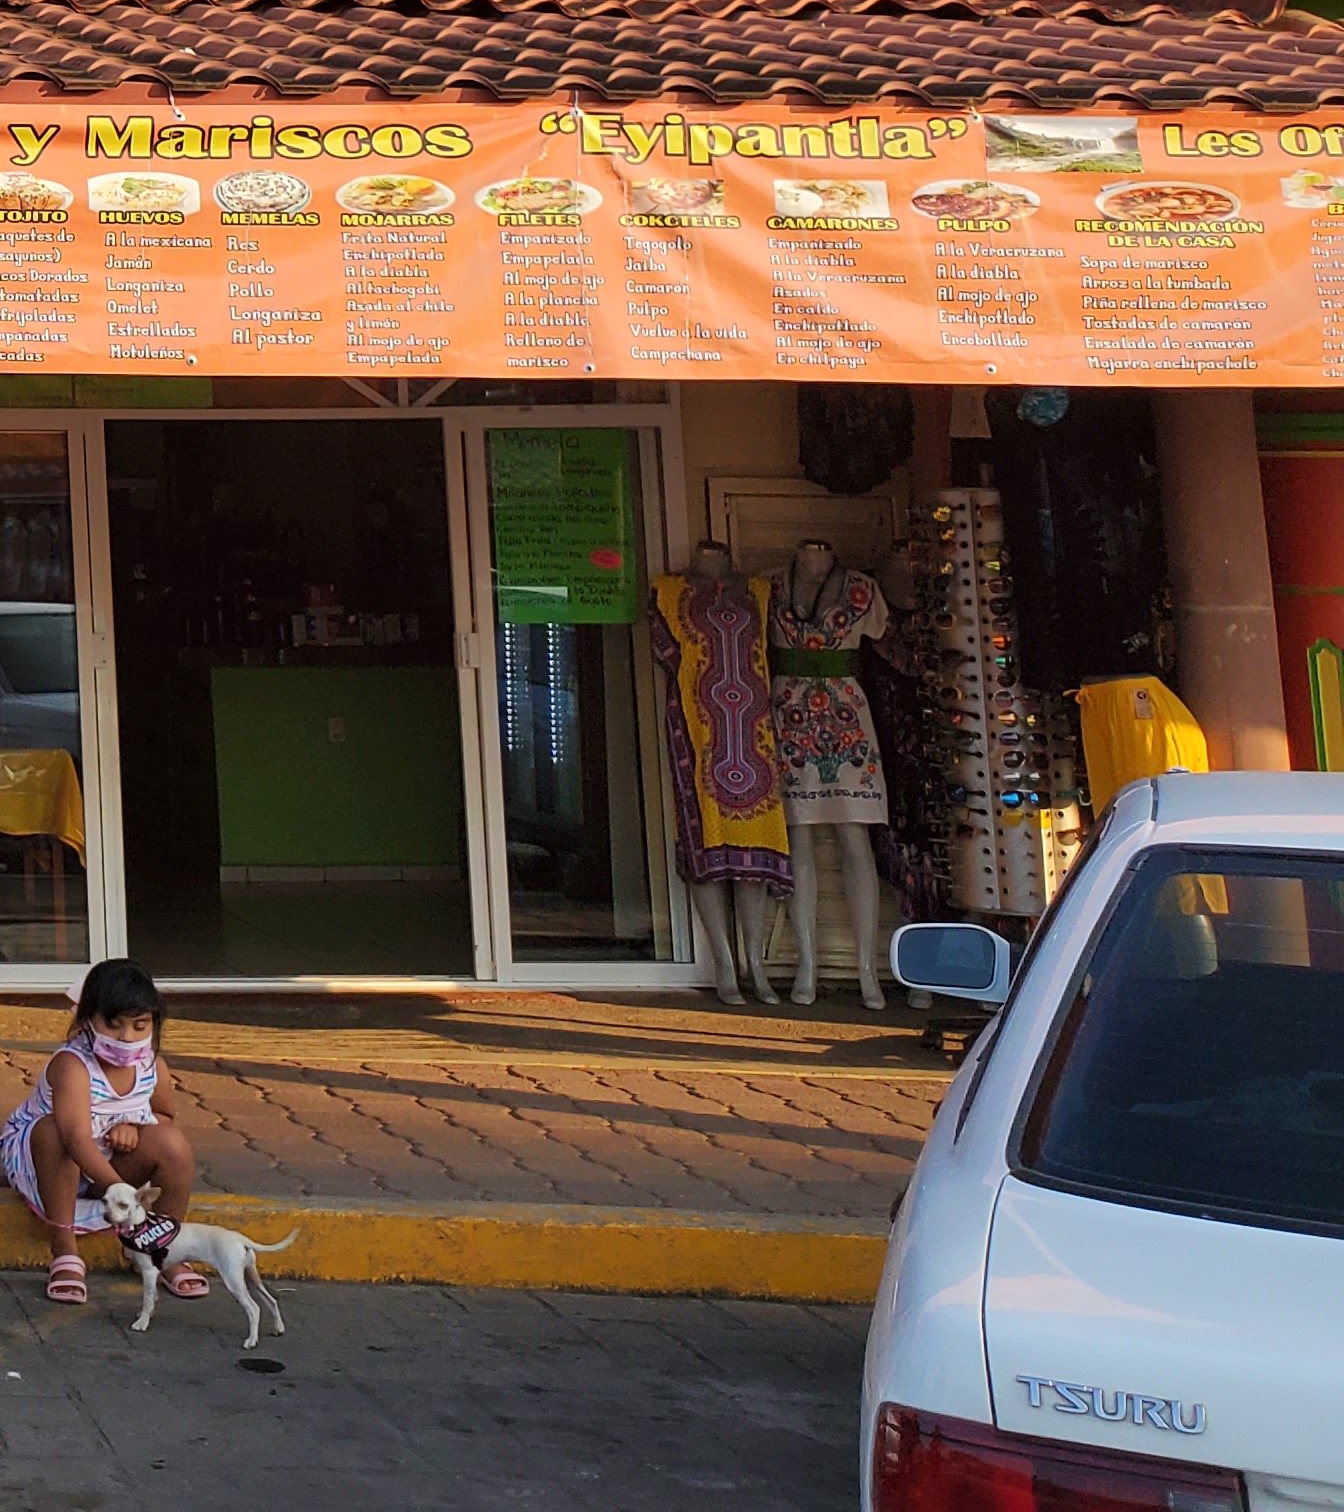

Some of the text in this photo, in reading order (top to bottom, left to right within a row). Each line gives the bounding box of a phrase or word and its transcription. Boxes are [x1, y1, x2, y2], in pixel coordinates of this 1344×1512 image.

[8, 122, 60, 166] y
[85, 115, 473, 160] Mariscos
[1163, 124, 1262, 158] Les
[99, 210, 184, 225] HUEVOS
[221, 211, 320, 227] MEMELAS
[340, 212, 456, 229] MOJARRAS
[498, 212, 581, 227] FILETES
[619, 214, 742, 230] COKCTELES
[766, 216, 900, 232] CAMARONES
[937, 218, 1011, 233] PULPO
[1074, 219, 1265, 234] RECOMENDACIÓN
[105, 231, 212, 248] A la mexicana
[227, 236, 259, 252] Res
[1108, 235, 1236, 248] DE LA CASA
[105, 254, 152, 270] Jamón
[227, 259, 275, 275] Cerdo
[1080, 255, 1209, 274] Sopa de marisco
[105, 277, 185, 298] Longaniza
[228, 282, 274, 297] Pollo
[1081, 275, 1231, 291] Arroz a la tumbada
[106, 299, 159, 314] Omelet
[1082, 295, 1267, 310] Piña rellena de marisco
[230, 306, 322, 327] Longaniza
[1082, 314, 1253, 330] Tostadas de camarón
[107, 320, 196, 337] Estrellados
[231, 328, 314, 350] Al pastor
[1083, 336, 1255, 350] Ensalada de camarón
[109, 343, 185, 359] Motuleños
[1086, 356, 1259, 376] Mojarra enchipachole
[1016, 1374, 1208, 1435] TSURU
